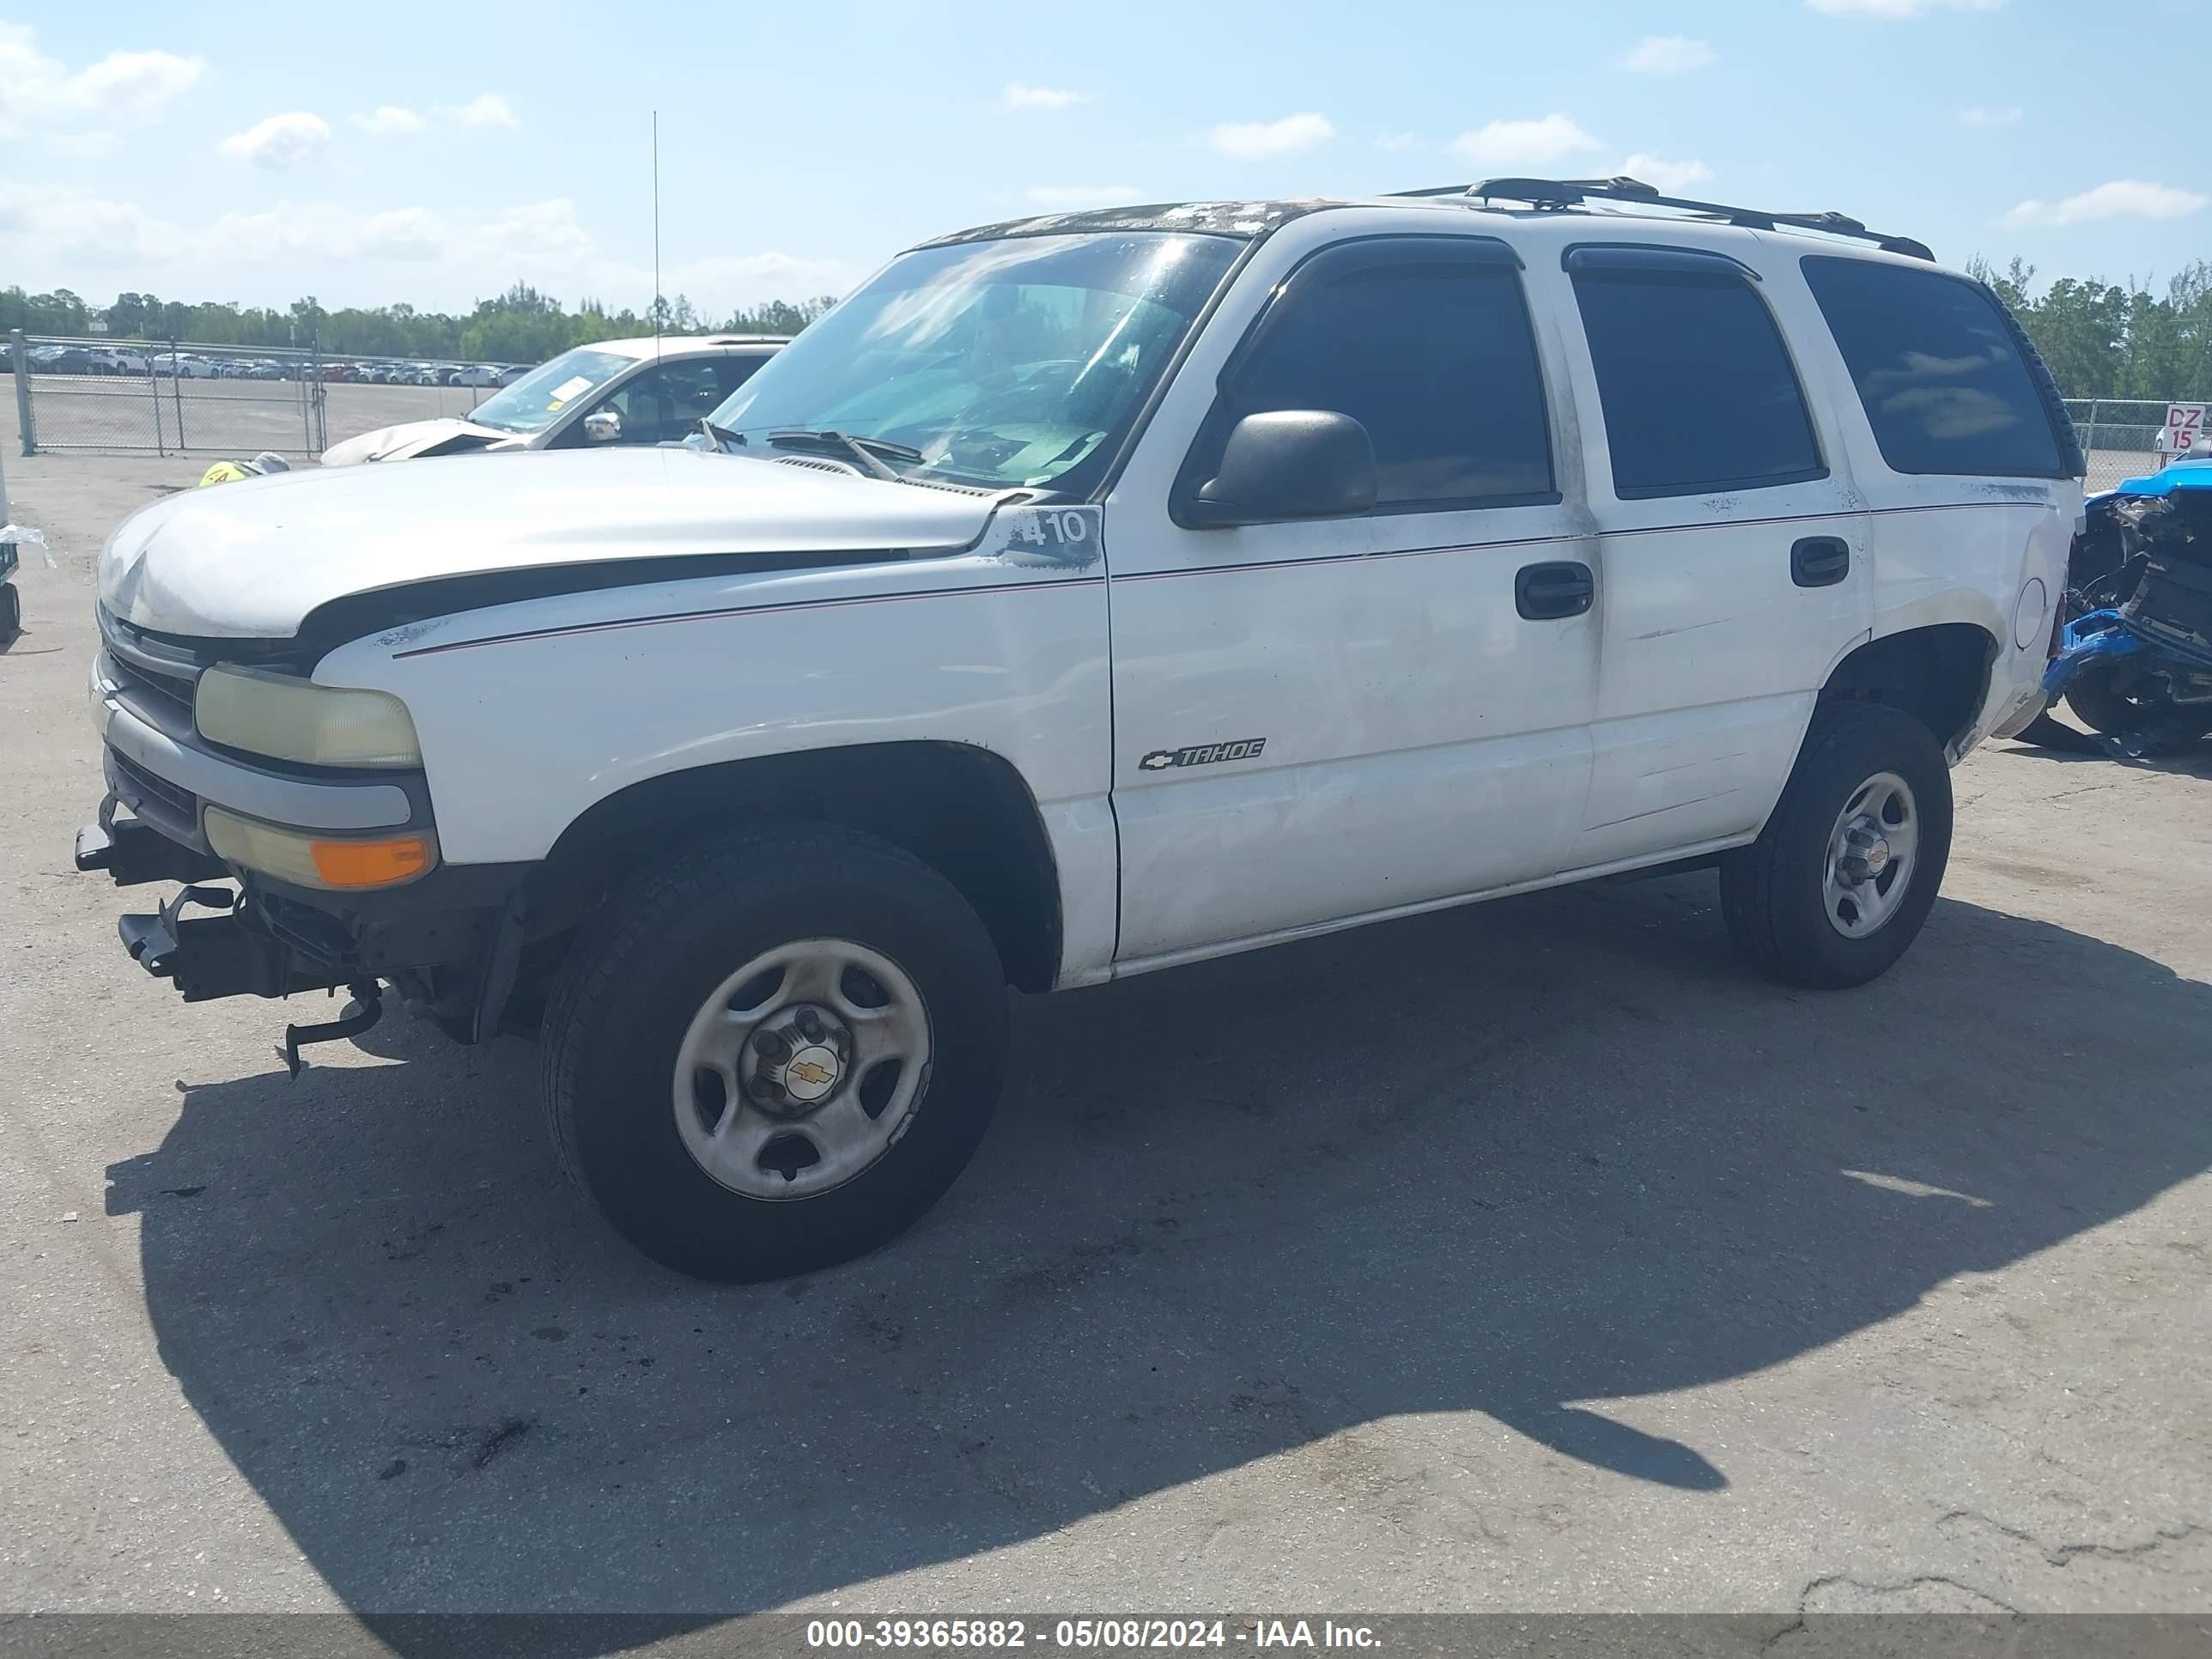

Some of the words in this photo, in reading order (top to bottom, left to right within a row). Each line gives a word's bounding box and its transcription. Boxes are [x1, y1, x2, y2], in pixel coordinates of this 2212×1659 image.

[2169, 408, 2201, 428] DZ
[2172, 430, 2192, 449] 15
[1182, 740, 1266, 765] TAHOE
